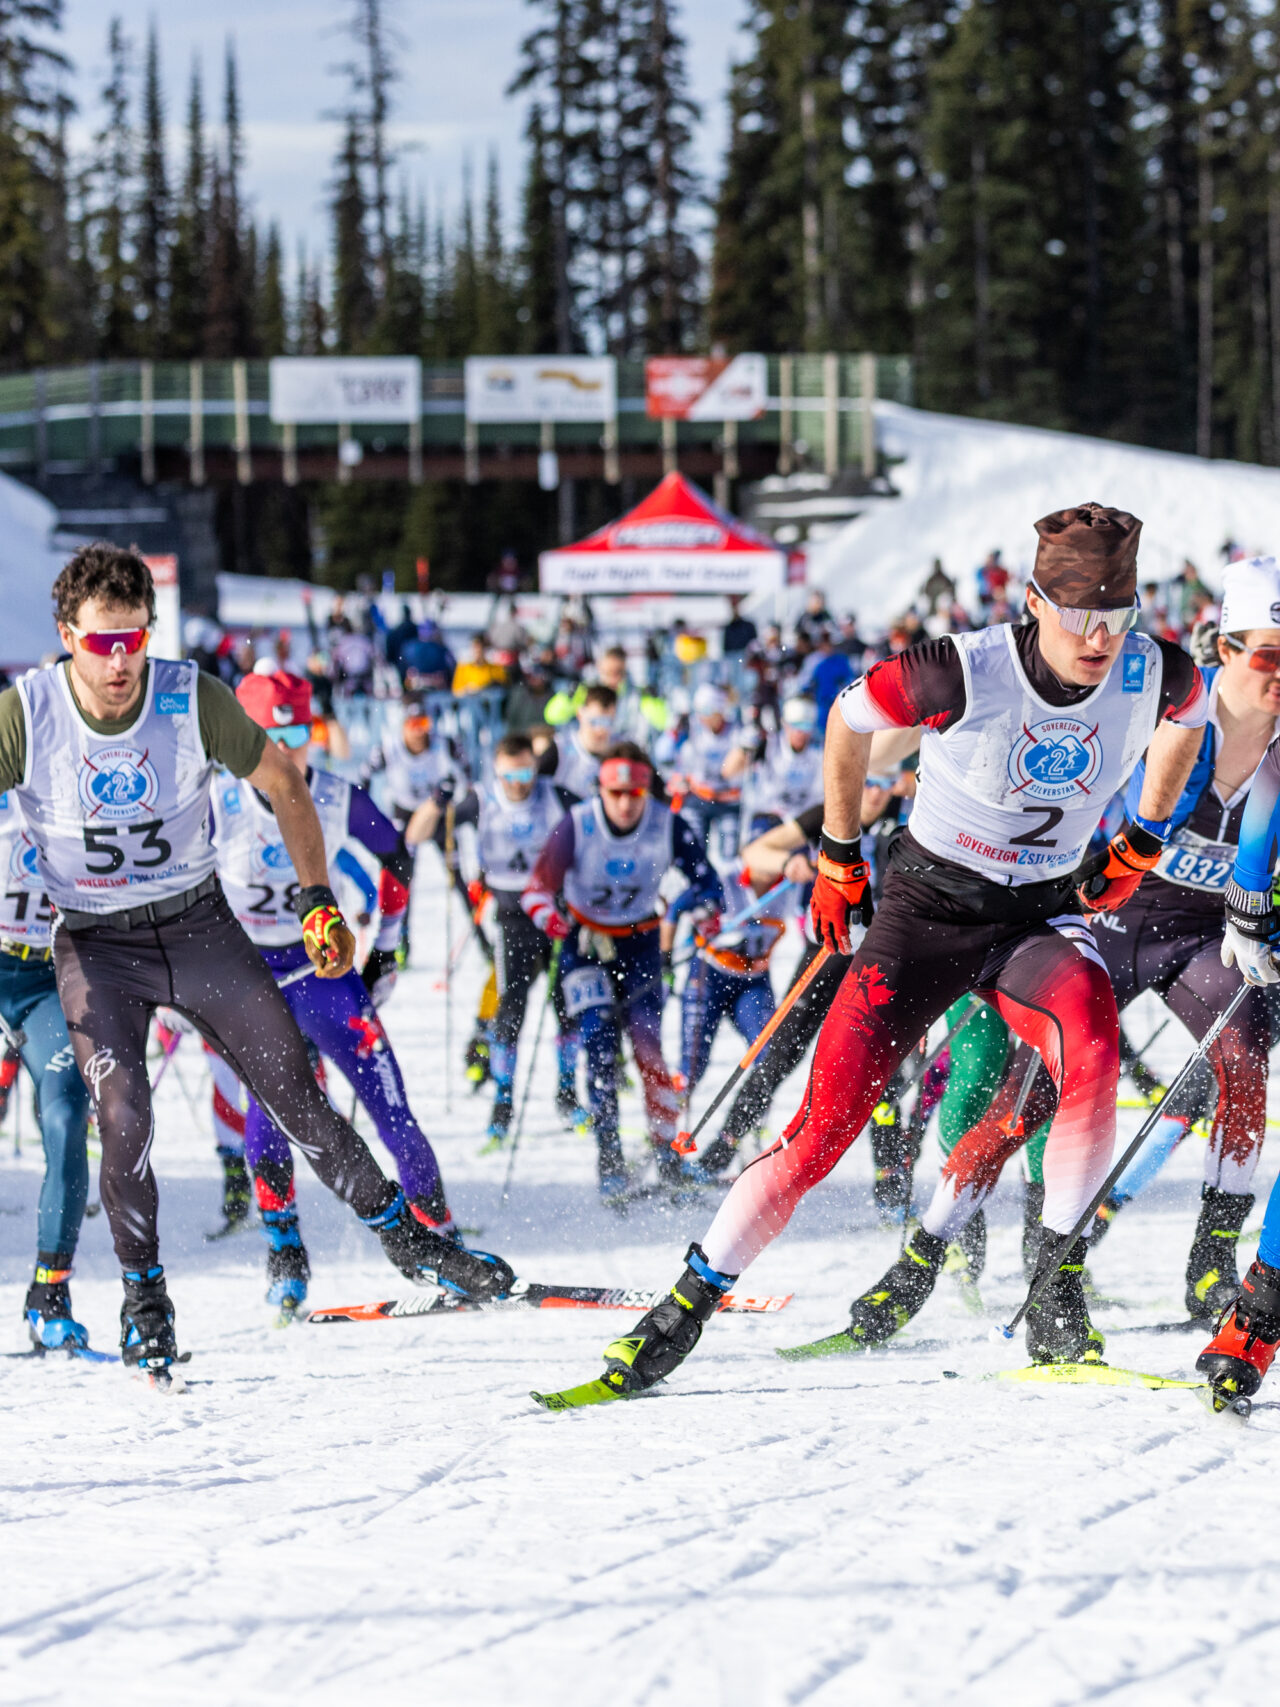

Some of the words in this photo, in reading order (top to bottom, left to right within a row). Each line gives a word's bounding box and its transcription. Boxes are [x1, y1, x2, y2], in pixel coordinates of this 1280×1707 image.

[1041, 722, 1081, 733] SOVEREIGN
[1048, 748, 1067, 776] 2
[1029, 784, 1076, 796] SILVERSTAR
[1008, 806, 1065, 848] 2
[83, 818, 172, 875] 53
[1173, 853, 1230, 887] 932
